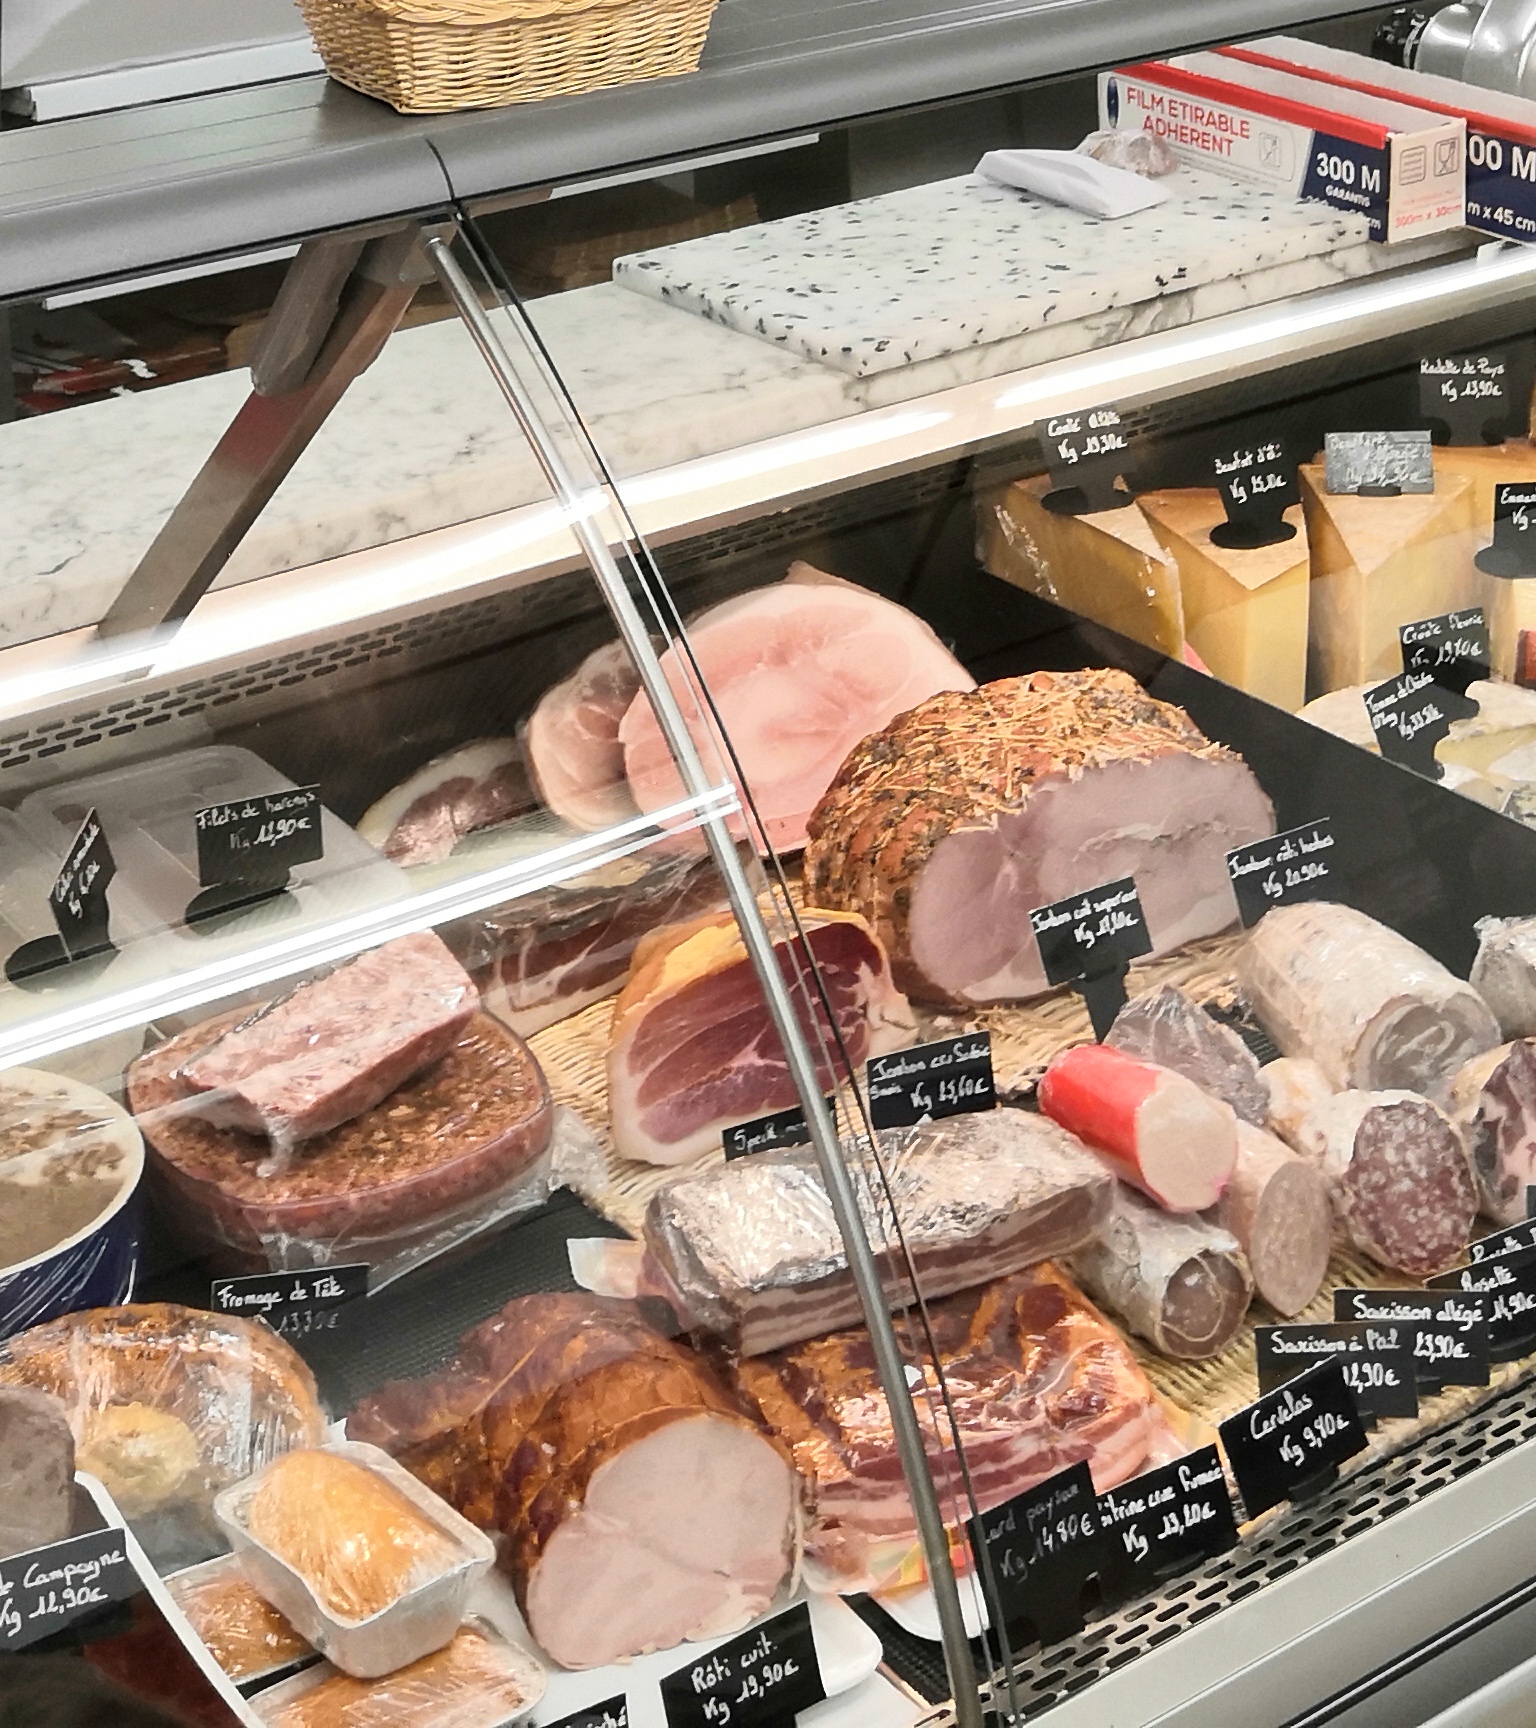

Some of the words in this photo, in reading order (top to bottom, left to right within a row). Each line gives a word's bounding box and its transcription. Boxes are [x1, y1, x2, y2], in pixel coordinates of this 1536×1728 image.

[1126, 87, 1164, 119] FILM
[1168, 100, 1251, 141] ETIRABLE
[1141, 114, 1235, 158] ADHERENT
[1465, 133, 1503, 171] 00
[1316, 152, 1356, 185] 300
[1361, 168, 1381, 194] M
[1494, 205, 1514, 226] 45
[1441, 380, 1458, 402] Kg
[1057, 437, 1079, 465] Kg
[1228, 476, 1249, 505] Kg
[1511, 505, 1529, 532] Kg
[194, 809, 239, 831] Filets
[240, 804, 261, 820] de
[1261, 870, 1284, 899] Kg
[1073, 921, 1096, 949] Kg
[910, 1081, 934, 1112] Kg
[217, 1284, 284, 1311] Fromage
[289, 1281, 308, 1301] de
[1351, 1293, 1432, 1321] Saucisson
[1270, 1329, 1347, 1355] Saucisson
[1249, 1389, 1314, 1441] Cervelas
[1278, 1433, 1306, 1467] Kg
[1095, 1493, 1146, 1529] oitrine
[1028, 1511, 1095, 1566] 14,80€
[1122, 1523, 1150, 1564] Kg
[21, 1546, 126, 1591] Campagne
[690, 1655, 731, 1695] Rôti
[701, 1696, 732, 1727] Kg
[735, 1657, 800, 1705] 19,90€
